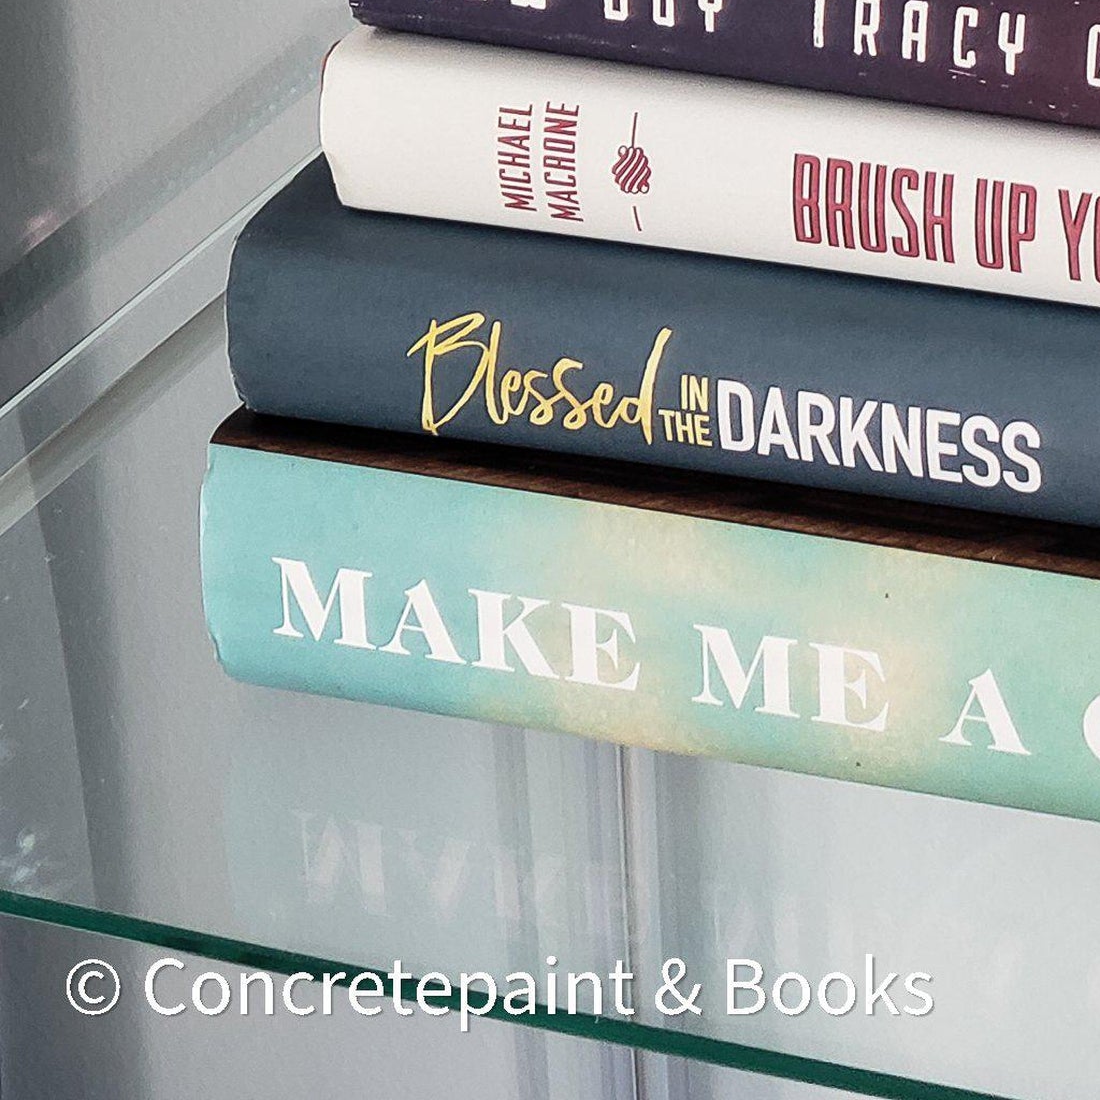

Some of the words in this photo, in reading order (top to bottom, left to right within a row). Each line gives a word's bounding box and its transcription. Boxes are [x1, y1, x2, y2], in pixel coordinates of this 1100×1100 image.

[497, 103, 538, 211] MICHAEL
[543, 102, 583, 221] MACRONE
[792, 153, 955, 264] BRUSH
[975, 178, 1037, 273] UP
[407, 313, 673, 445] Blessed
[658, 408, 713, 448] THE
[681, 374, 710, 412] IN
[716, 378, 1042, 494] DARKNESS
[271, 556, 641, 691] MAKE
[691, 623, 889, 733] ME
[938, 668, 1033, 757] A
